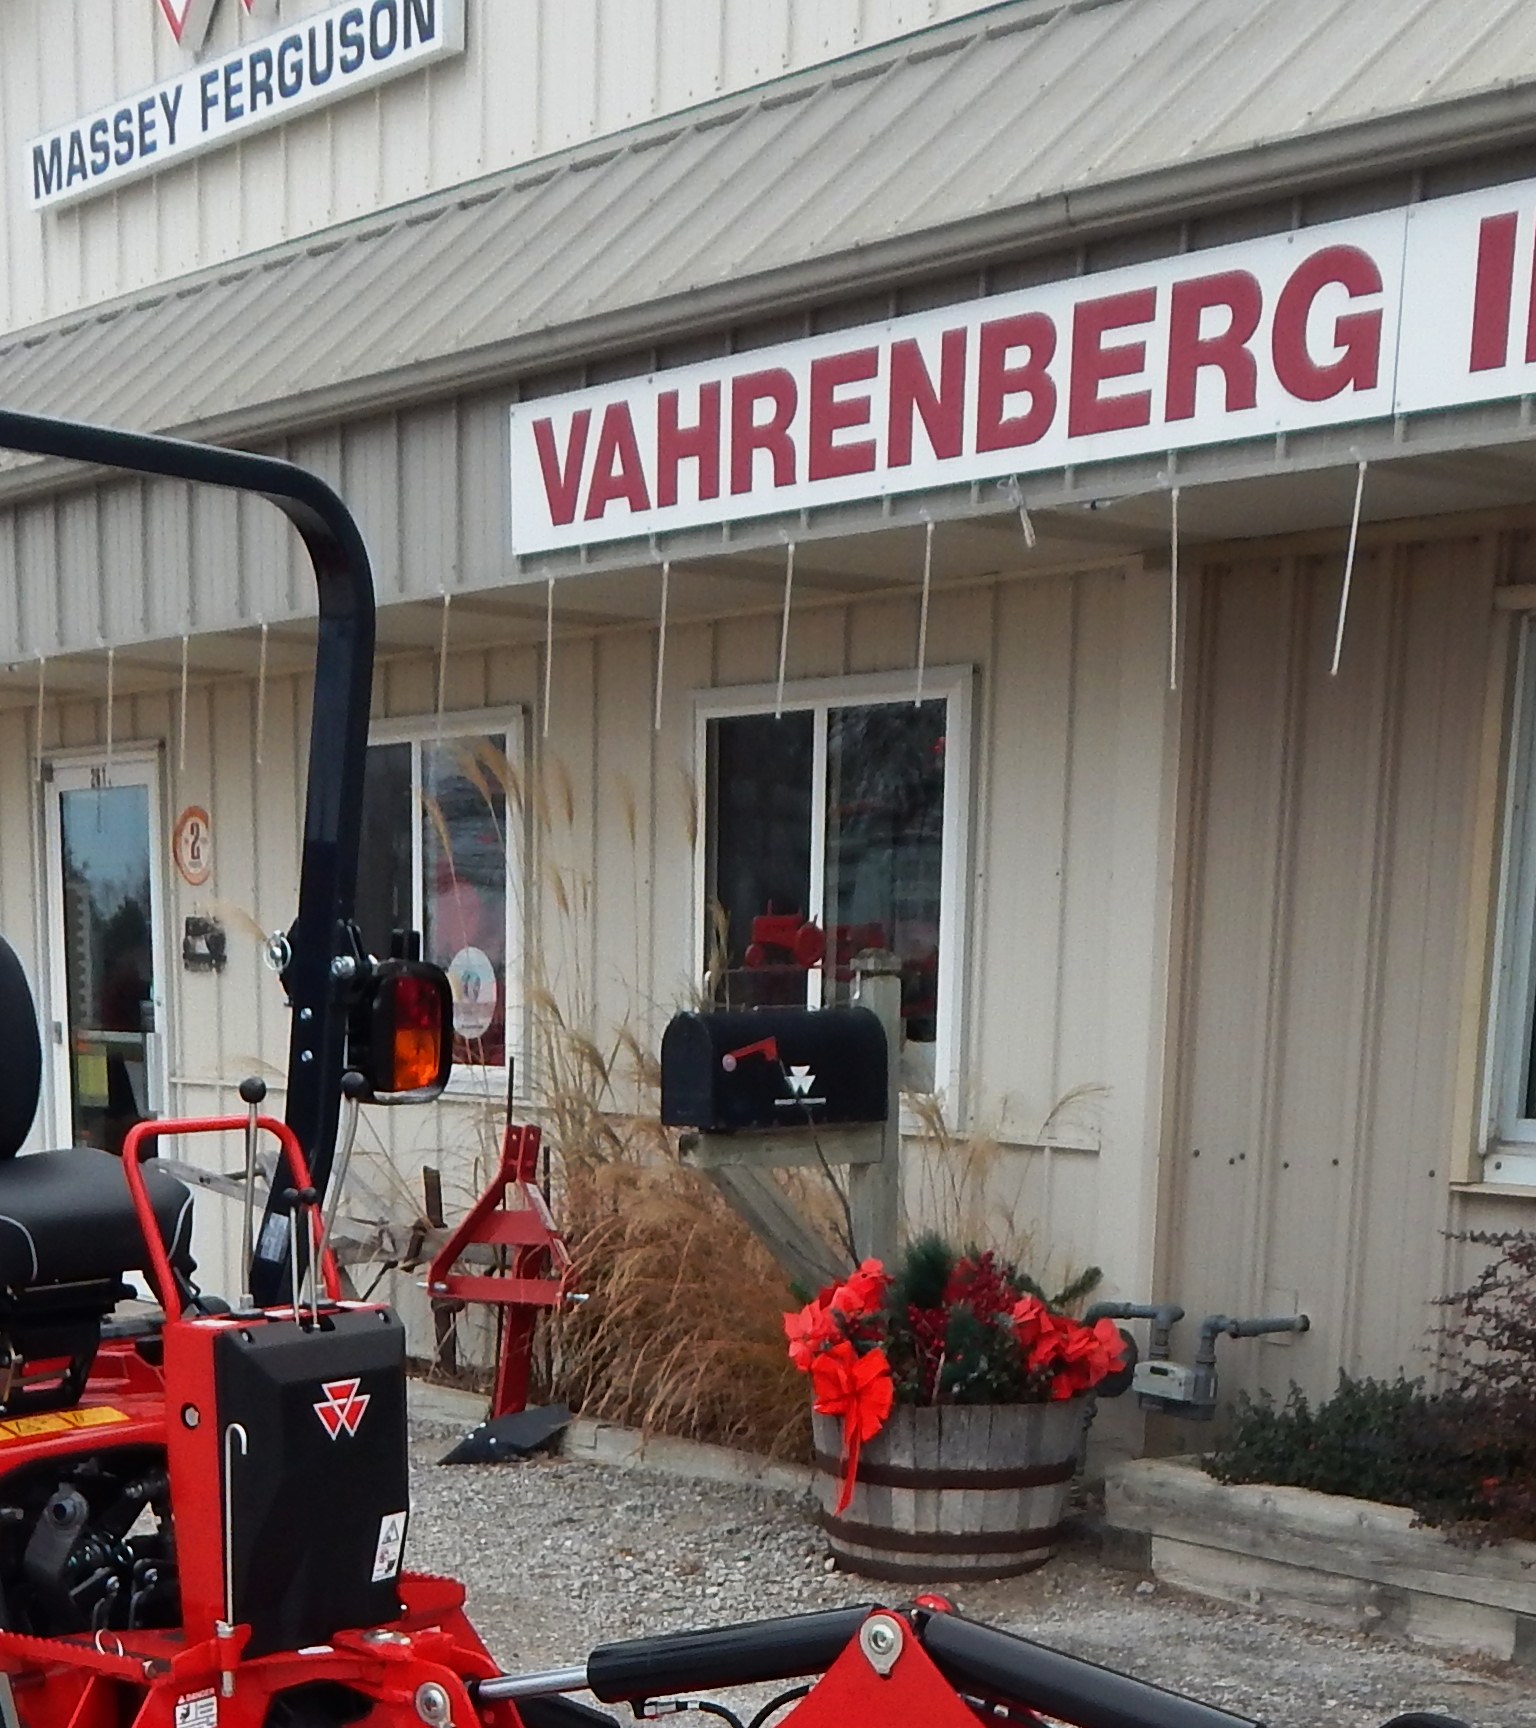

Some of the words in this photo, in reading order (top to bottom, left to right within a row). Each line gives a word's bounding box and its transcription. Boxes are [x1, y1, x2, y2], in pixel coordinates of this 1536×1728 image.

[32, 83, 183, 199] MASSEY
[200, 0, 437, 133] FERGUSON
[531, 243, 1384, 527] VAHRENBERG
[190, 822, 201, 860] 2
